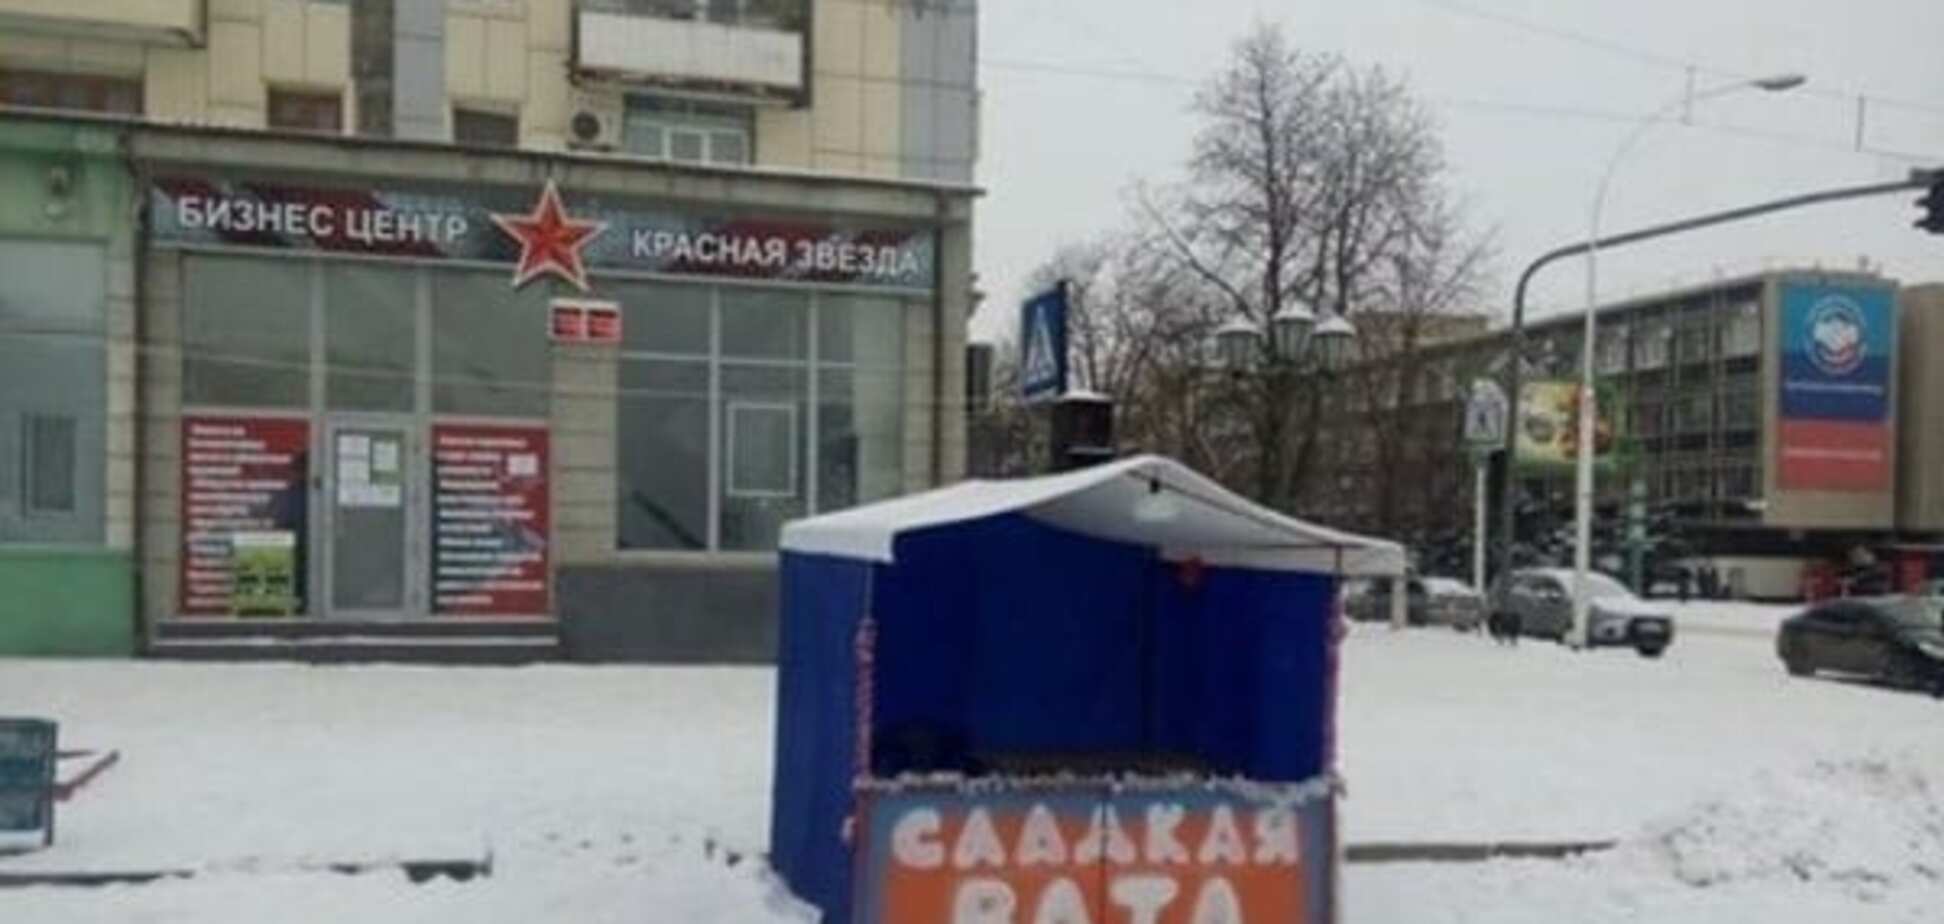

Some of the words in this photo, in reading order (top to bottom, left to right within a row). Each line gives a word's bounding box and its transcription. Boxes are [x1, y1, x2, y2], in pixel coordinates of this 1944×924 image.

[178, 196, 338, 236] БИЗНЕС
[345, 209, 468, 246] ЦЕНТР
[633, 229, 787, 265] КРАСНАЯ
[795, 239, 919, 277] ЗВЕЗДА
[892, 803, 1300, 869] СЛАДКАЯ
